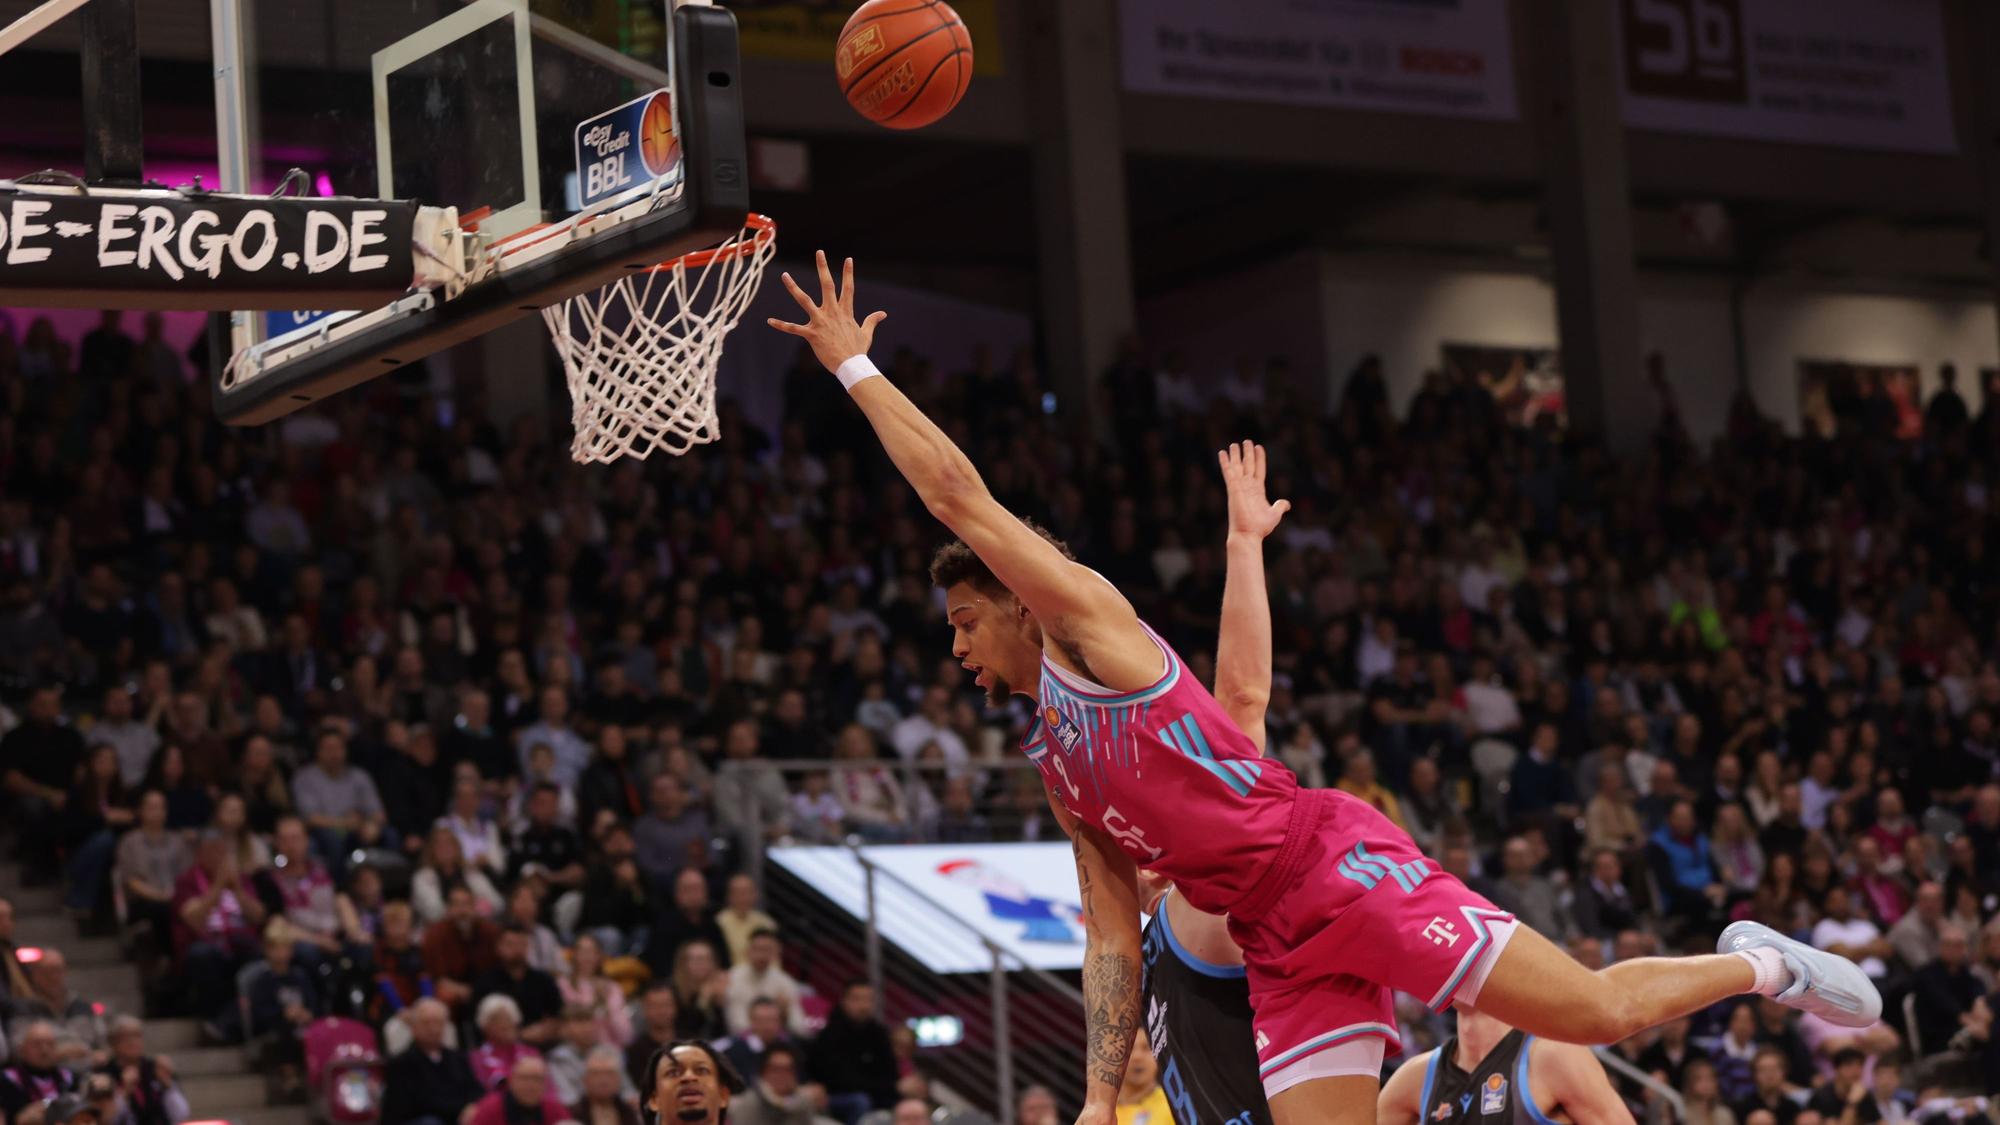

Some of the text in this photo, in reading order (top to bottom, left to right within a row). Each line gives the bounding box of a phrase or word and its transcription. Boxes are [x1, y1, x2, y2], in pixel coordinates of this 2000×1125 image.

[1399, 45, 1484, 76] BOSCH
[587, 152, 631, 199] BBL
[0, 201, 389, 281] E-ERGO.DE
